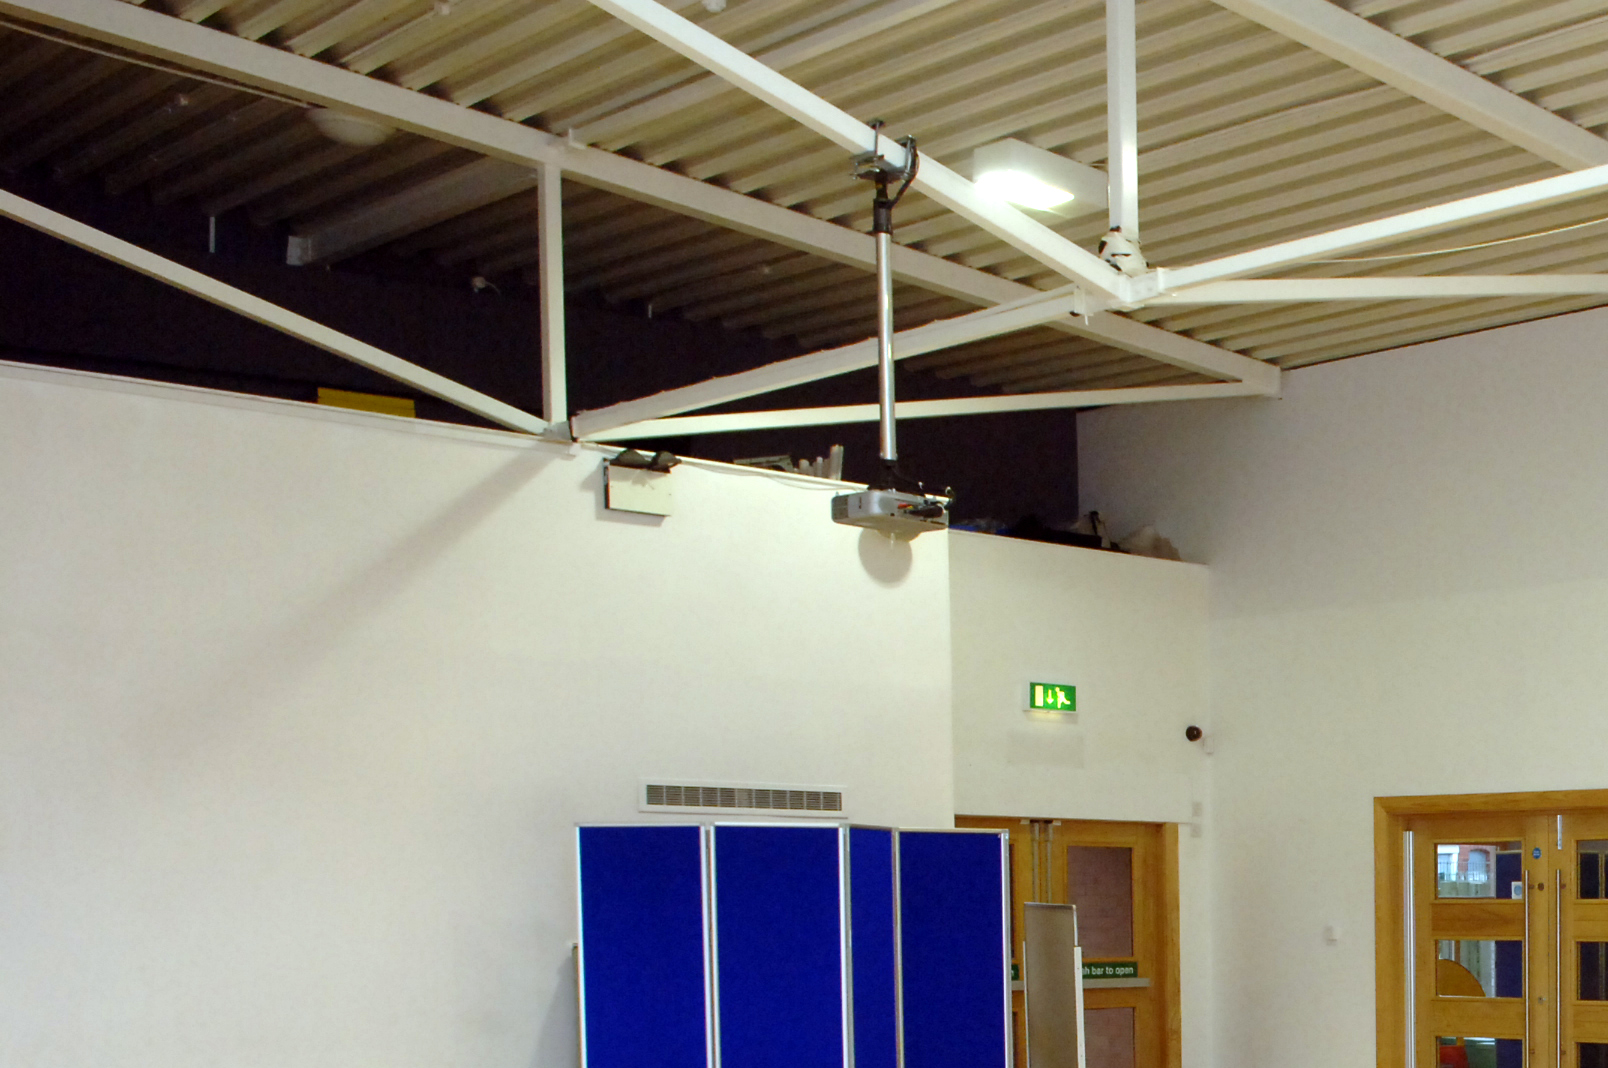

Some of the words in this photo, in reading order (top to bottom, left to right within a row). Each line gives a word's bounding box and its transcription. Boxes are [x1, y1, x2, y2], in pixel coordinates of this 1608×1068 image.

[1091, 966, 1104, 975] bar
[1105, 966, 1114, 975] to
[1115, 966, 1134, 976] open
